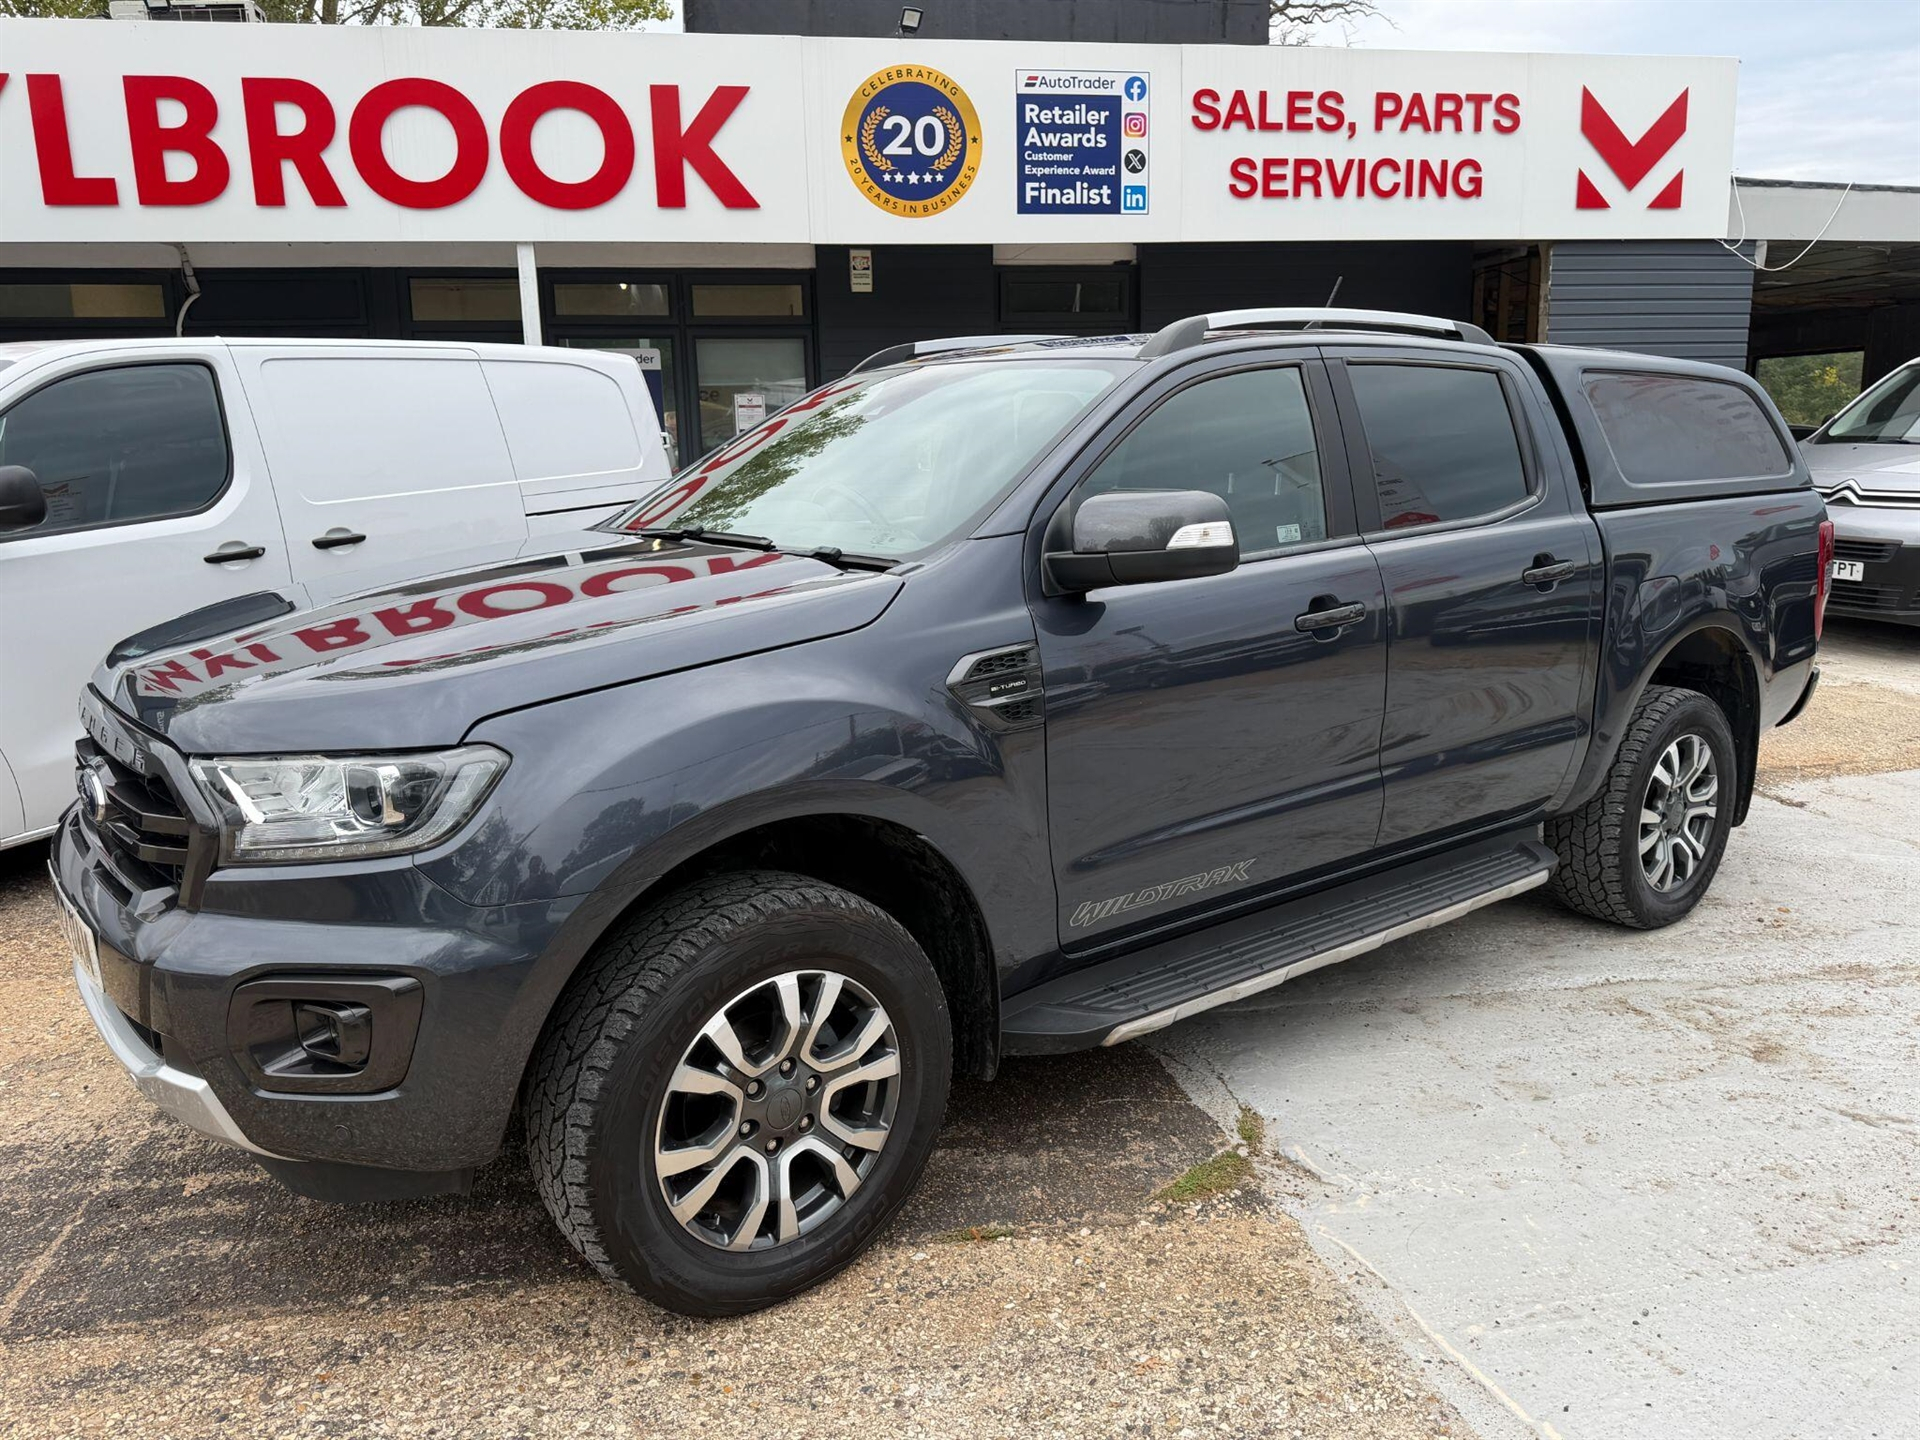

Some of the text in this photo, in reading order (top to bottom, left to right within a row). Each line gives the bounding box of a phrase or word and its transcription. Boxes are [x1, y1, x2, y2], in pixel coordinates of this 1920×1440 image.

[862, 68, 959, 98] CELEBRATING
[1038, 76, 1116, 90] AutoTrader
[1025, 103, 1110, 125] Retailer
[1192, 88, 1522, 138] SALES, PARTS
[0, 73, 760, 210] LBROOK
[882, 115, 945, 157] 20
[1024, 126, 1107, 148] Awards
[1024, 150, 1074, 161] Customer
[1024, 164, 1116, 177] Experience Award
[849, 158, 976, 213] 20 YEARS IN BUSINESS
[1025, 181, 1112, 205] Finalist
[1228, 158, 1483, 199] SERVICING
[635, 353, 655, 364] der
[78, 696, 146, 774] ANGER
[1070, 858, 1257, 927] WILDTRAK
